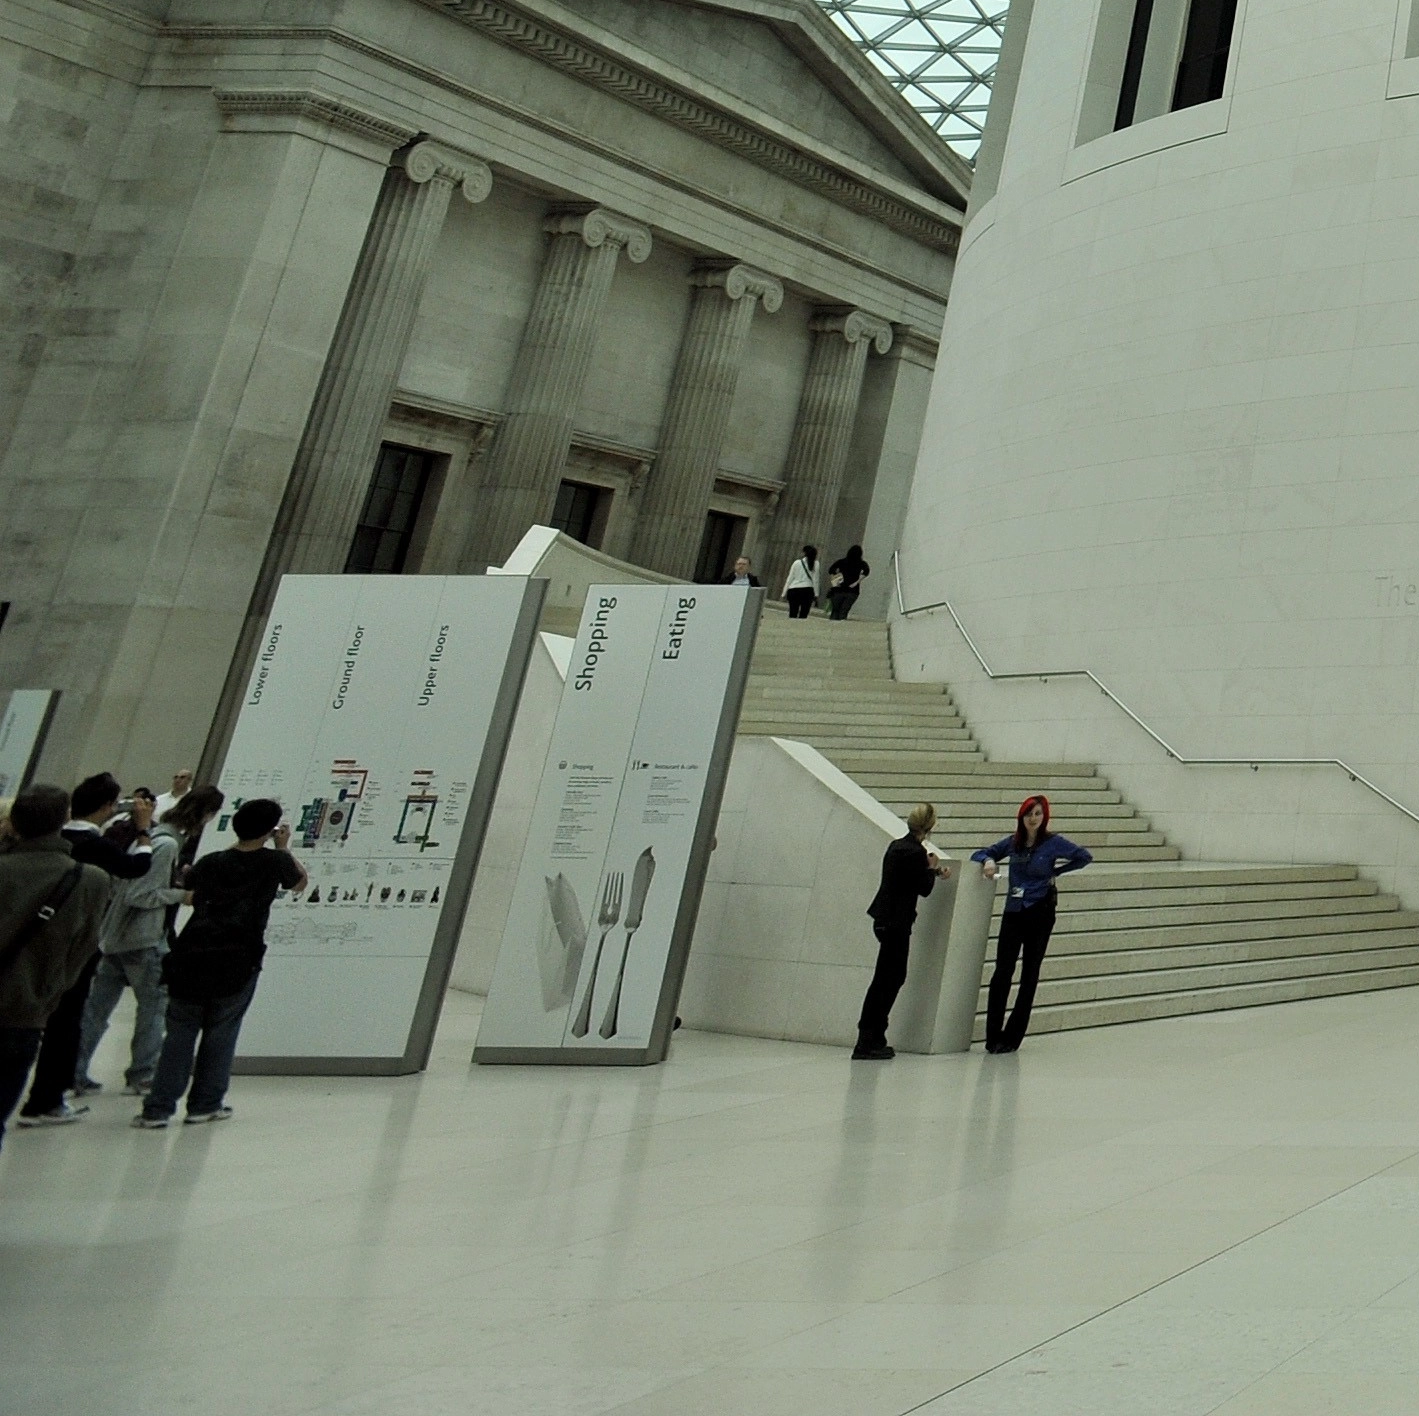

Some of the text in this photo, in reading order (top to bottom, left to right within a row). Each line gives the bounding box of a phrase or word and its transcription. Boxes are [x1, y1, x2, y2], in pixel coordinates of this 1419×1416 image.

[662, 597, 697, 660] Eating
[1374, 574, 1417, 608] The
[248, 624, 283, 706] Lower floors
[333, 625, 365, 710] Ground floor
[417, 624, 450, 706] Upper floors
[574, 596, 618, 692] Shopping
